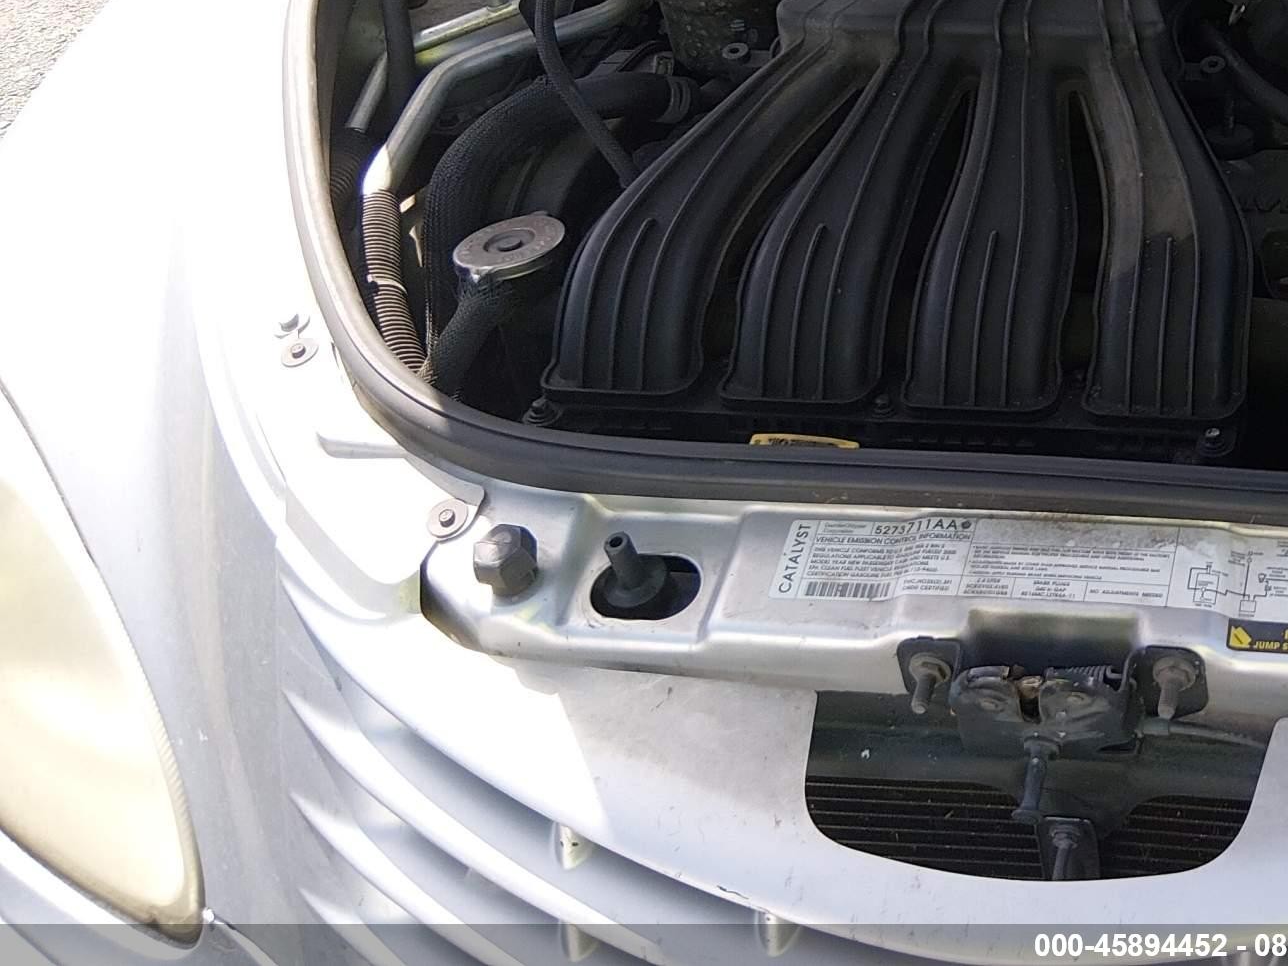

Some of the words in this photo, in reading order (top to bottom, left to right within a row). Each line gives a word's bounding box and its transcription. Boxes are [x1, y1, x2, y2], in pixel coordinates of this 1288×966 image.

[874, 518, 958, 536] 5273711AA
[815, 536, 847, 544] VEHICLE
[847, 537, 883, 545] EMISSION
[884, 535, 917, 545] CONTROL
[918, 532, 972, 541] INFORMATION
[778, 523, 812, 594] CATALYST
[1254, 641, 1281, 651] JUMP
